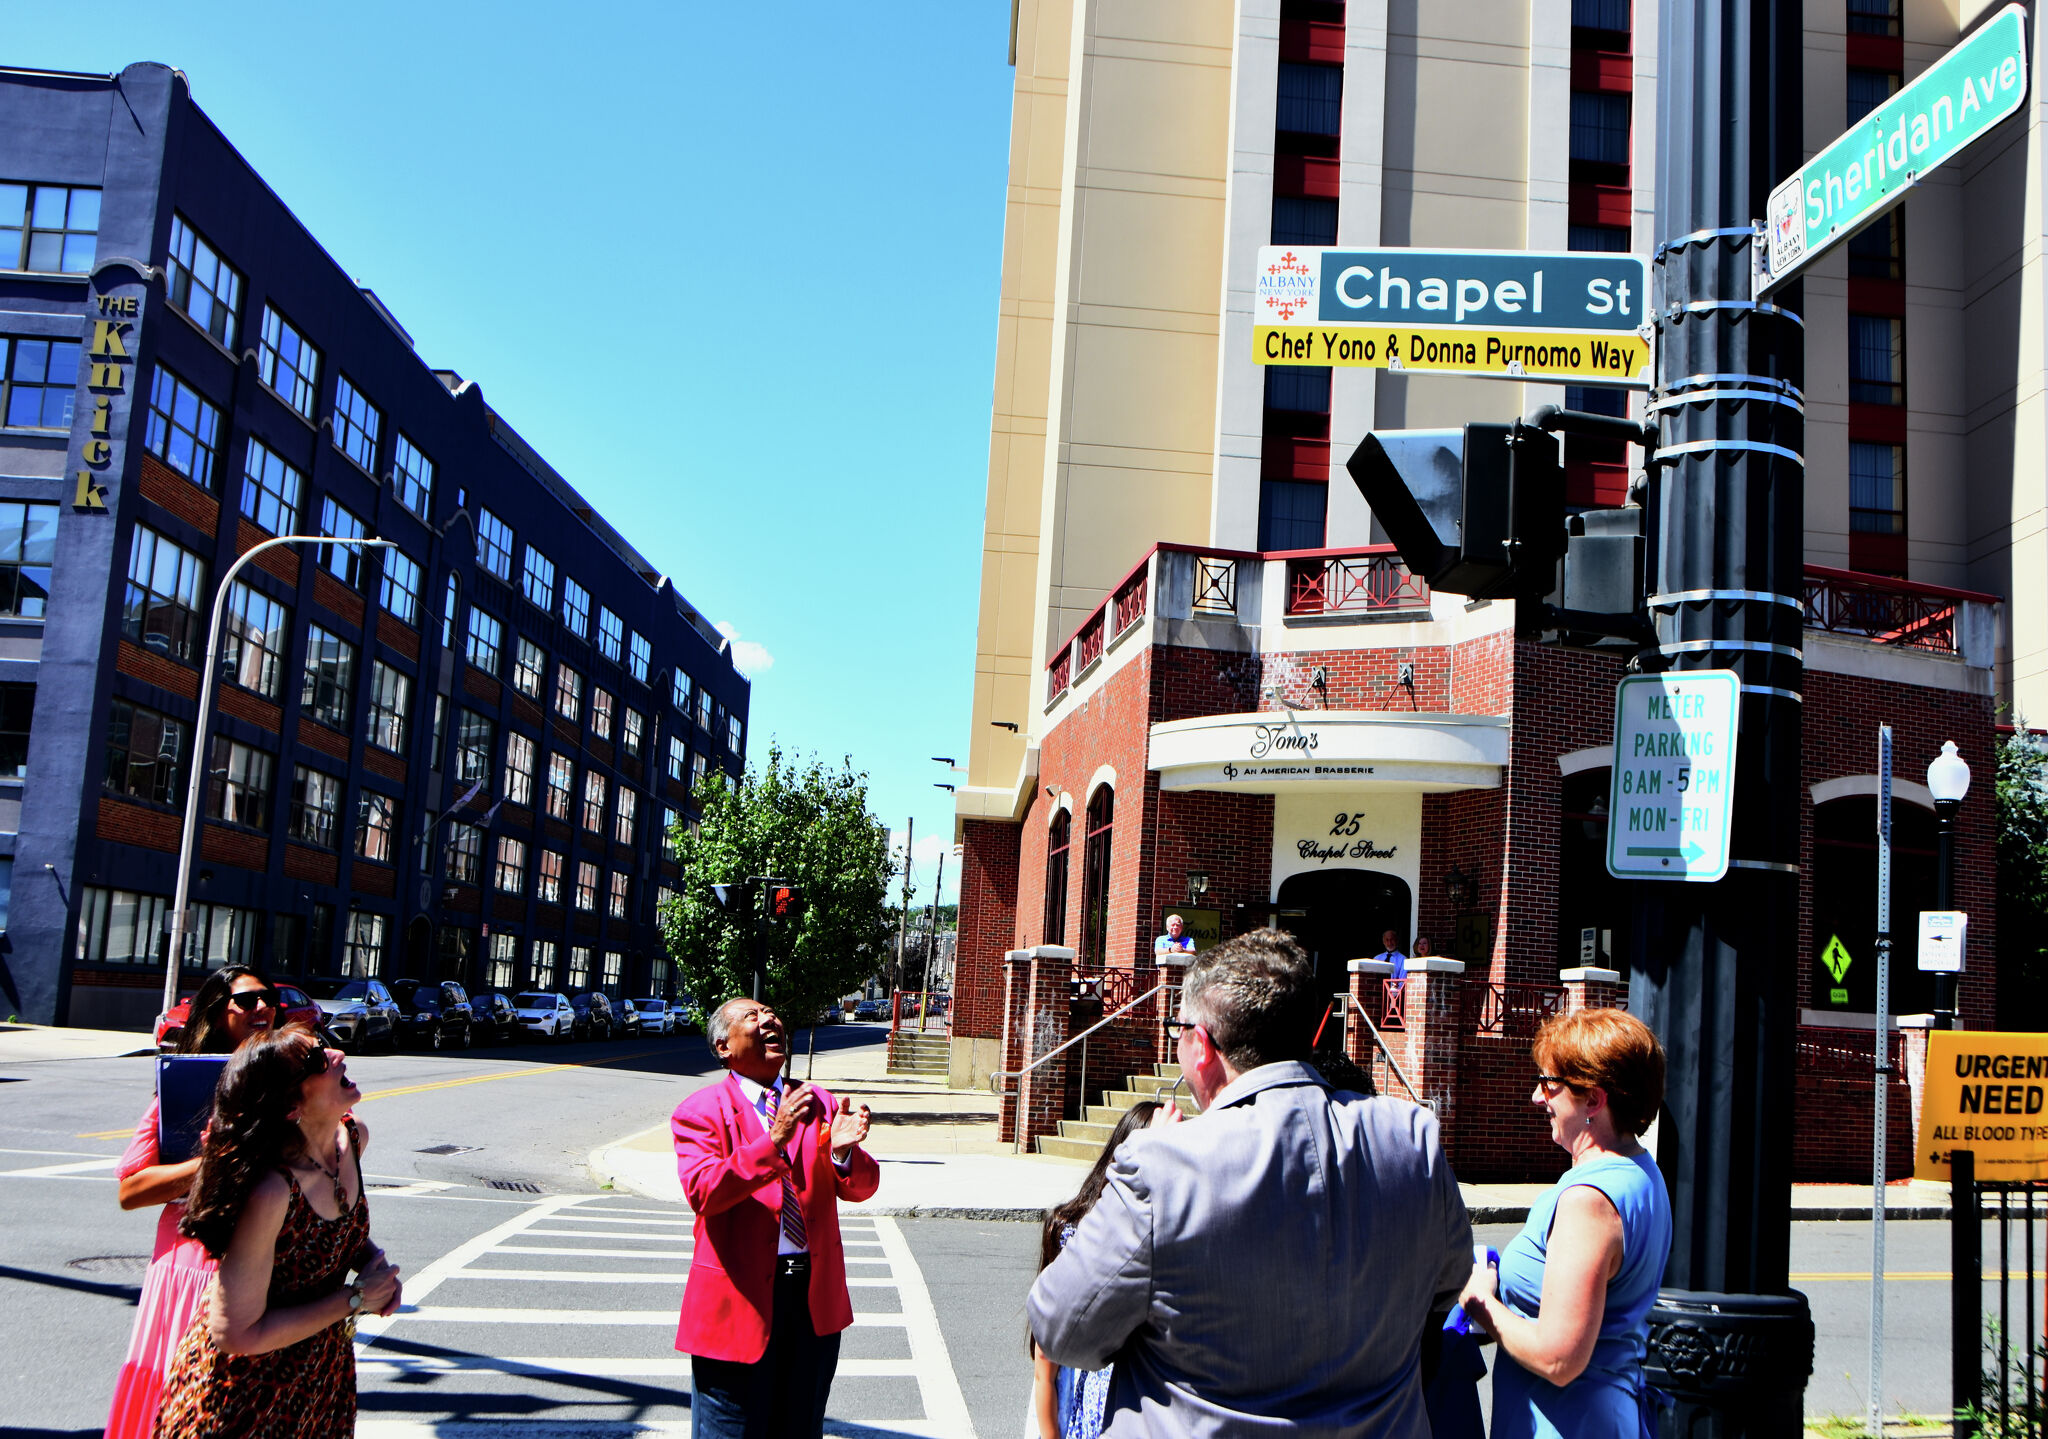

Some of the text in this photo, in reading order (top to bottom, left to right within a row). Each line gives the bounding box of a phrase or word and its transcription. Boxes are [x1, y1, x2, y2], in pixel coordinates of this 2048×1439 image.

[1806, 56, 2018, 229] Sheridan Ave
[1777, 234, 1800, 255] ALBANY
[1777, 246, 1801, 267] NEW YORK
[1259, 276, 1316, 287] ALBANY
[1260, 288, 1314, 297] NEW YORK
[1335, 265, 1631, 322] Chapel St
[96, 294, 137, 314] THE
[1265, 331, 1634, 377] Chef Yono & Donna Purnomo Way
[72, 319, 132, 512] Knick
[1648, 695, 1705, 720] METER
[1250, 724, 1319, 759] Yono's
[1634, 732, 1713, 757] PARKING
[1260, 767, 1310, 775] AMERICAN
[1315, 766, 1375, 774] BRASSERIE
[1329, 813, 1366, 836] 25
[1297, 840, 1398, 864] Chapel Street
[1959, 1084, 2044, 1115] NEED
[1933, 1125, 1958, 1140] ALL
[1964, 1126, 2015, 1141] BLOOD
